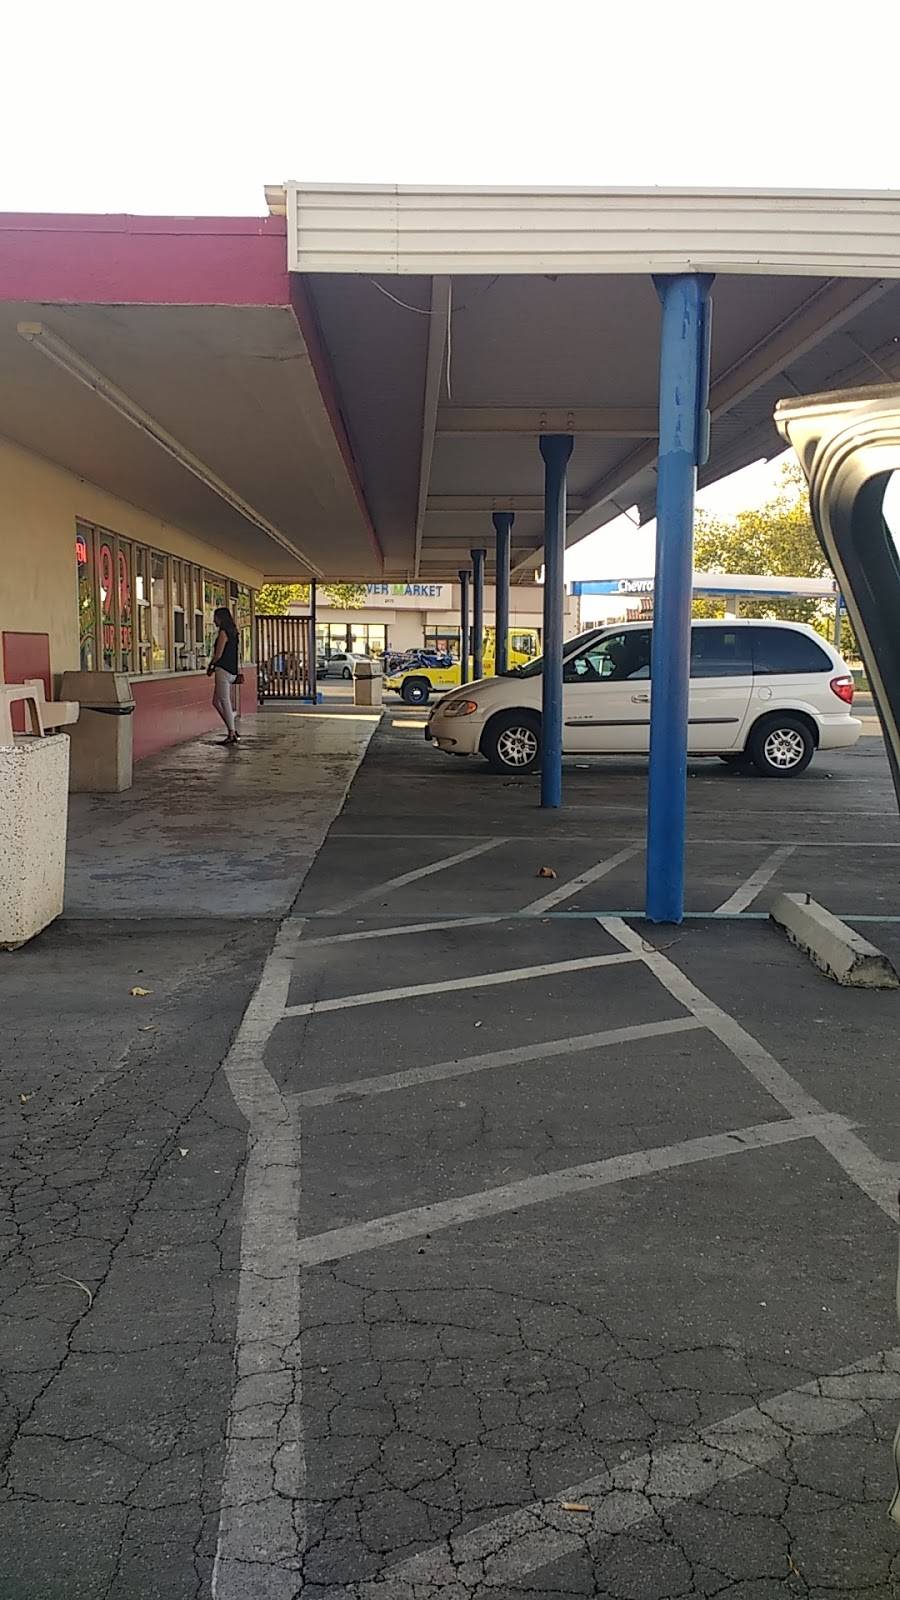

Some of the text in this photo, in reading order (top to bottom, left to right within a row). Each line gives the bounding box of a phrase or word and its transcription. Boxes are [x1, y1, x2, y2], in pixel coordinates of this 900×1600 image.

[367, 583, 443, 597] VER MARKET
[618, 579, 653, 592] Chevro
